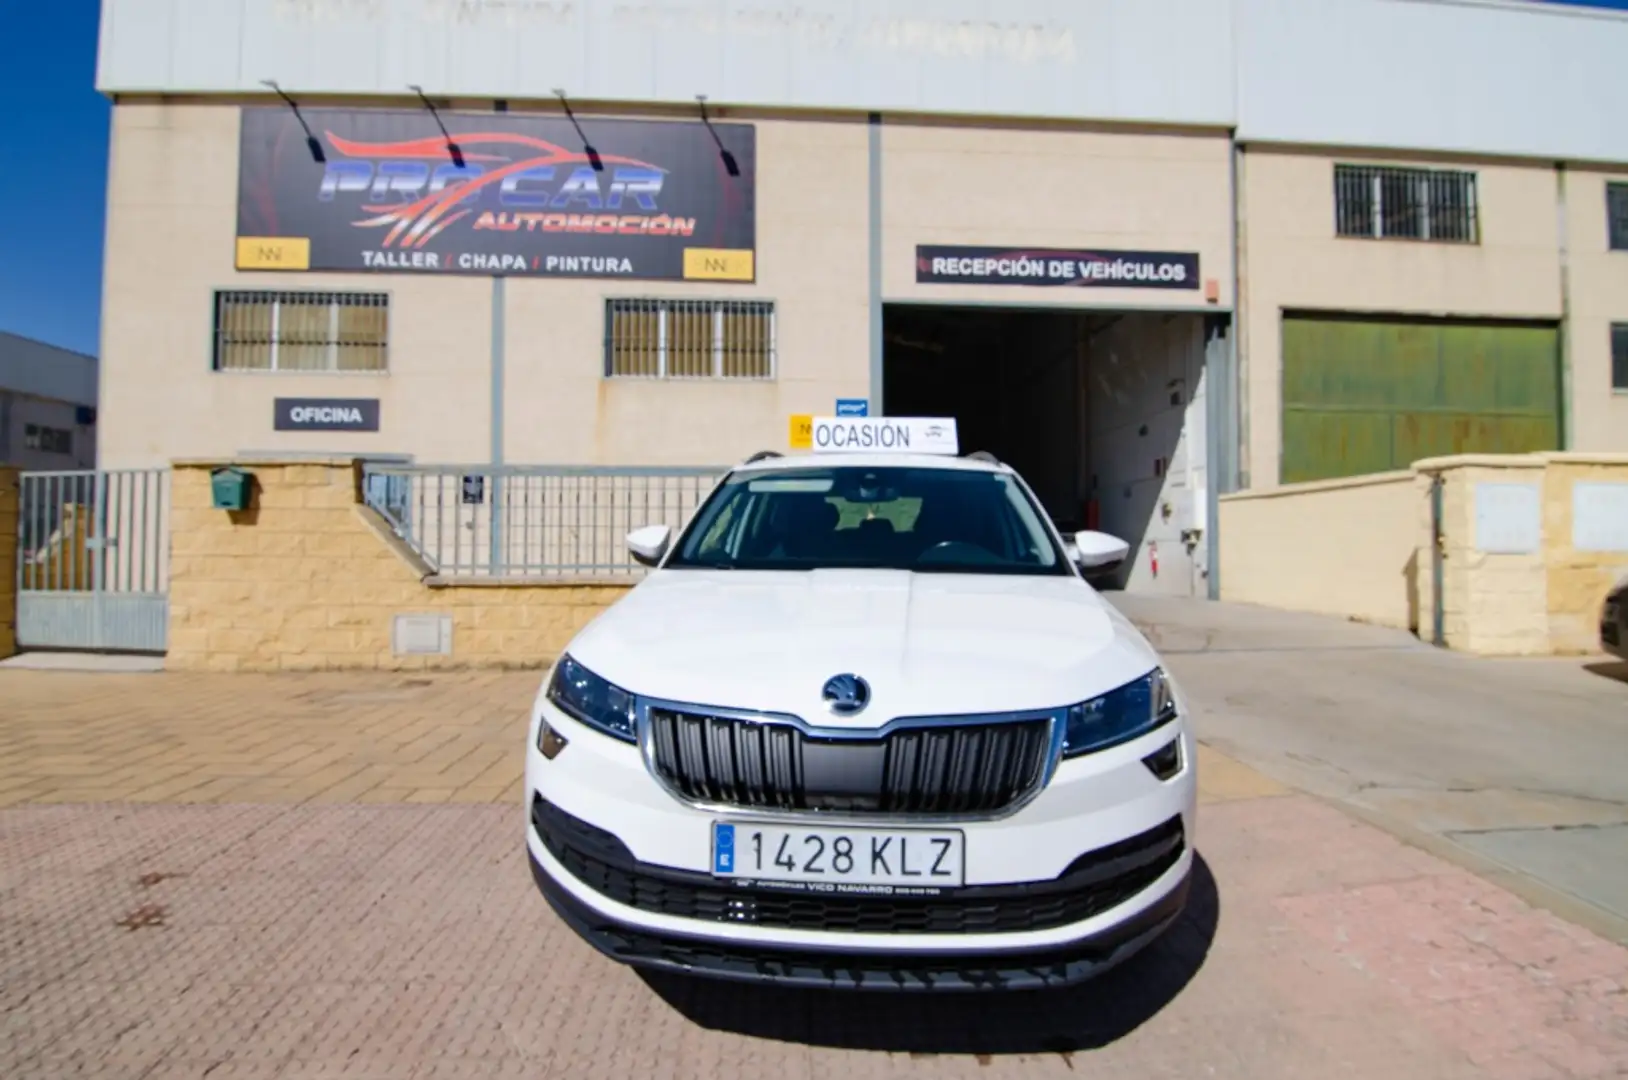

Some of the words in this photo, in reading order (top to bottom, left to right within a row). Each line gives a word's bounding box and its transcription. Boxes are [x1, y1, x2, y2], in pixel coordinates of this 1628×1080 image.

[317, 160, 484, 202] PRO
[500, 164, 666, 211] CAR
[473, 211, 697, 238] AUTOMOCIÓN
[361, 250, 440, 268] TALLER
[458, 254, 527, 271] CHAPA
[545, 255, 634, 273] PINTURA
[932, 255, 1045, 278] RECEPCIÓN
[1049, 260, 1076, 278] DE
[1079, 258, 1187, 281] VEHÍCULOS
[289, 405, 364, 424] OFICINA
[815, 419, 911, 448] OCASIÓN
[720, 853, 730, 866] E
[751, 832, 854, 875] 1428
[870, 836, 953, 876] KLZ
[807, 882, 835, 892] VICO
[838, 884, 894, 895] NAVARRO
